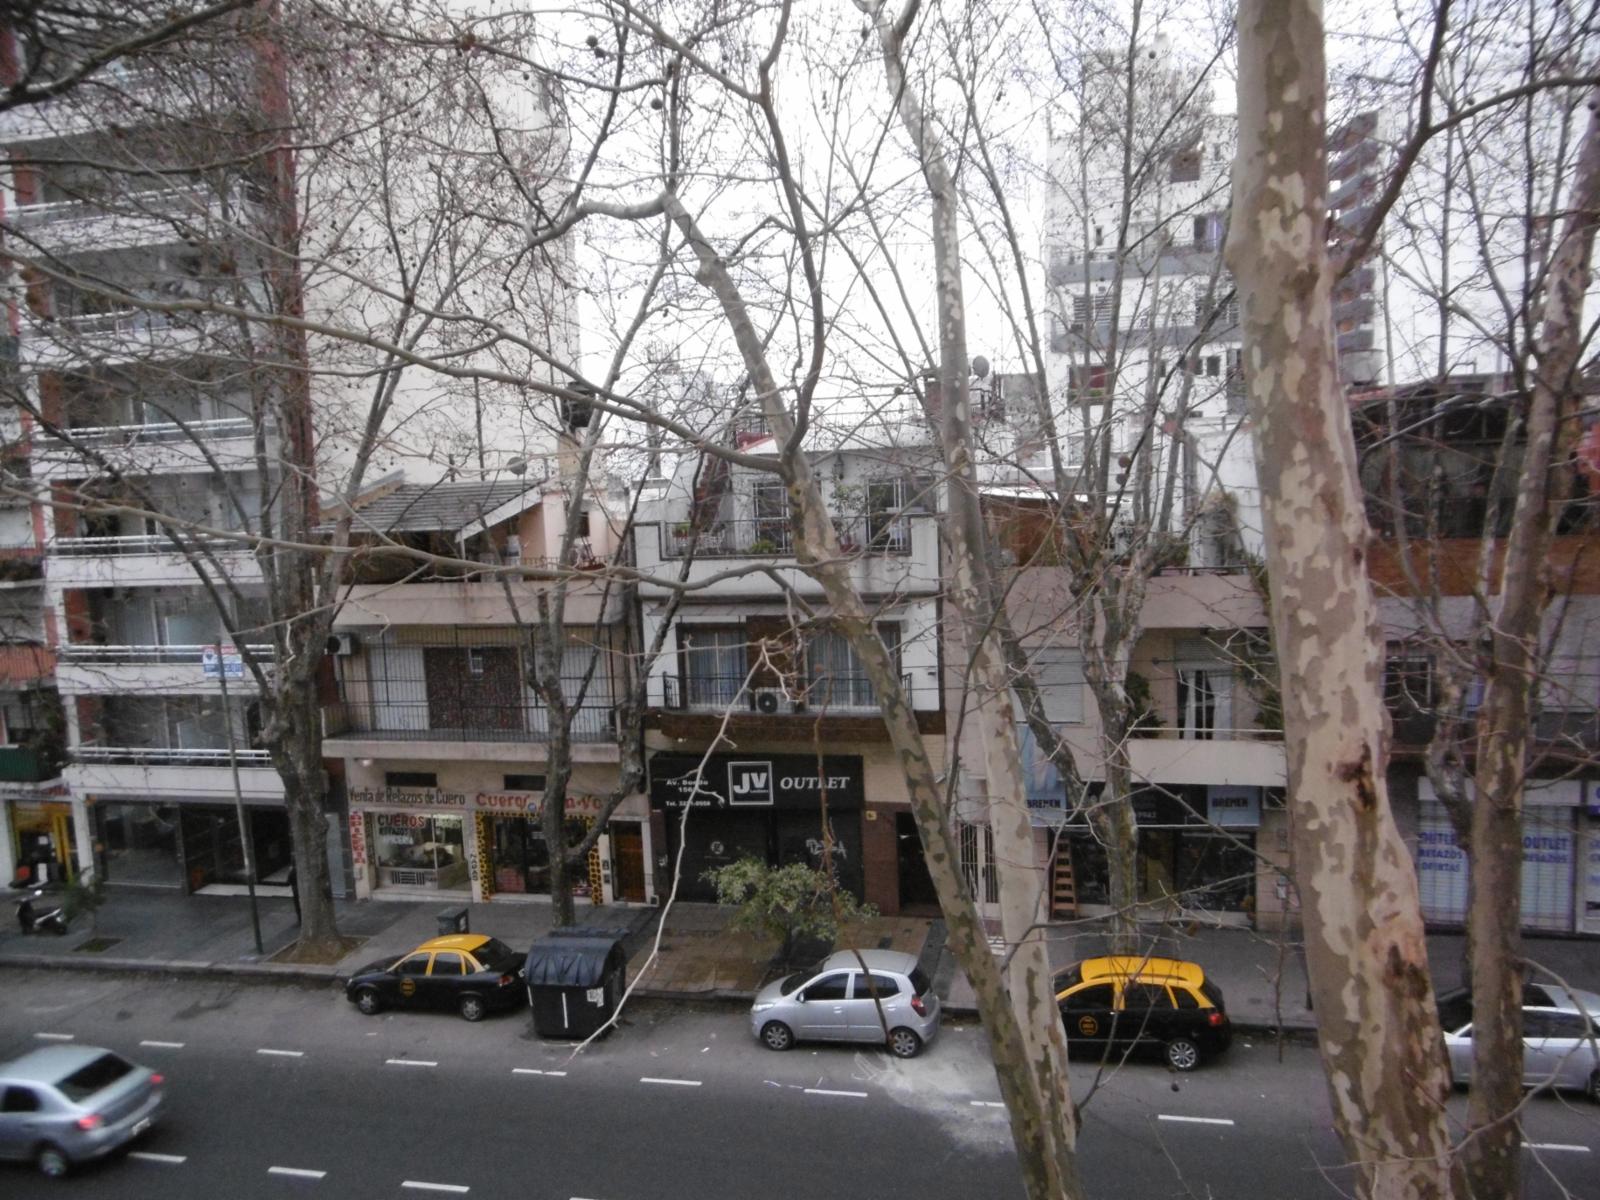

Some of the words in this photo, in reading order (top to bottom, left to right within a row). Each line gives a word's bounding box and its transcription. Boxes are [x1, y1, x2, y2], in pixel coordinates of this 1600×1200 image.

[733, 772, 768, 794] JV
[779, 776, 851, 790] OUTLET
[386, 786, 423, 804] Retazos
[424, 788, 435, 804] de
[436, 787, 466, 805] Cuero
[377, 813, 426, 828] CUEROS
[1523, 836, 1569, 849] OUTLET
